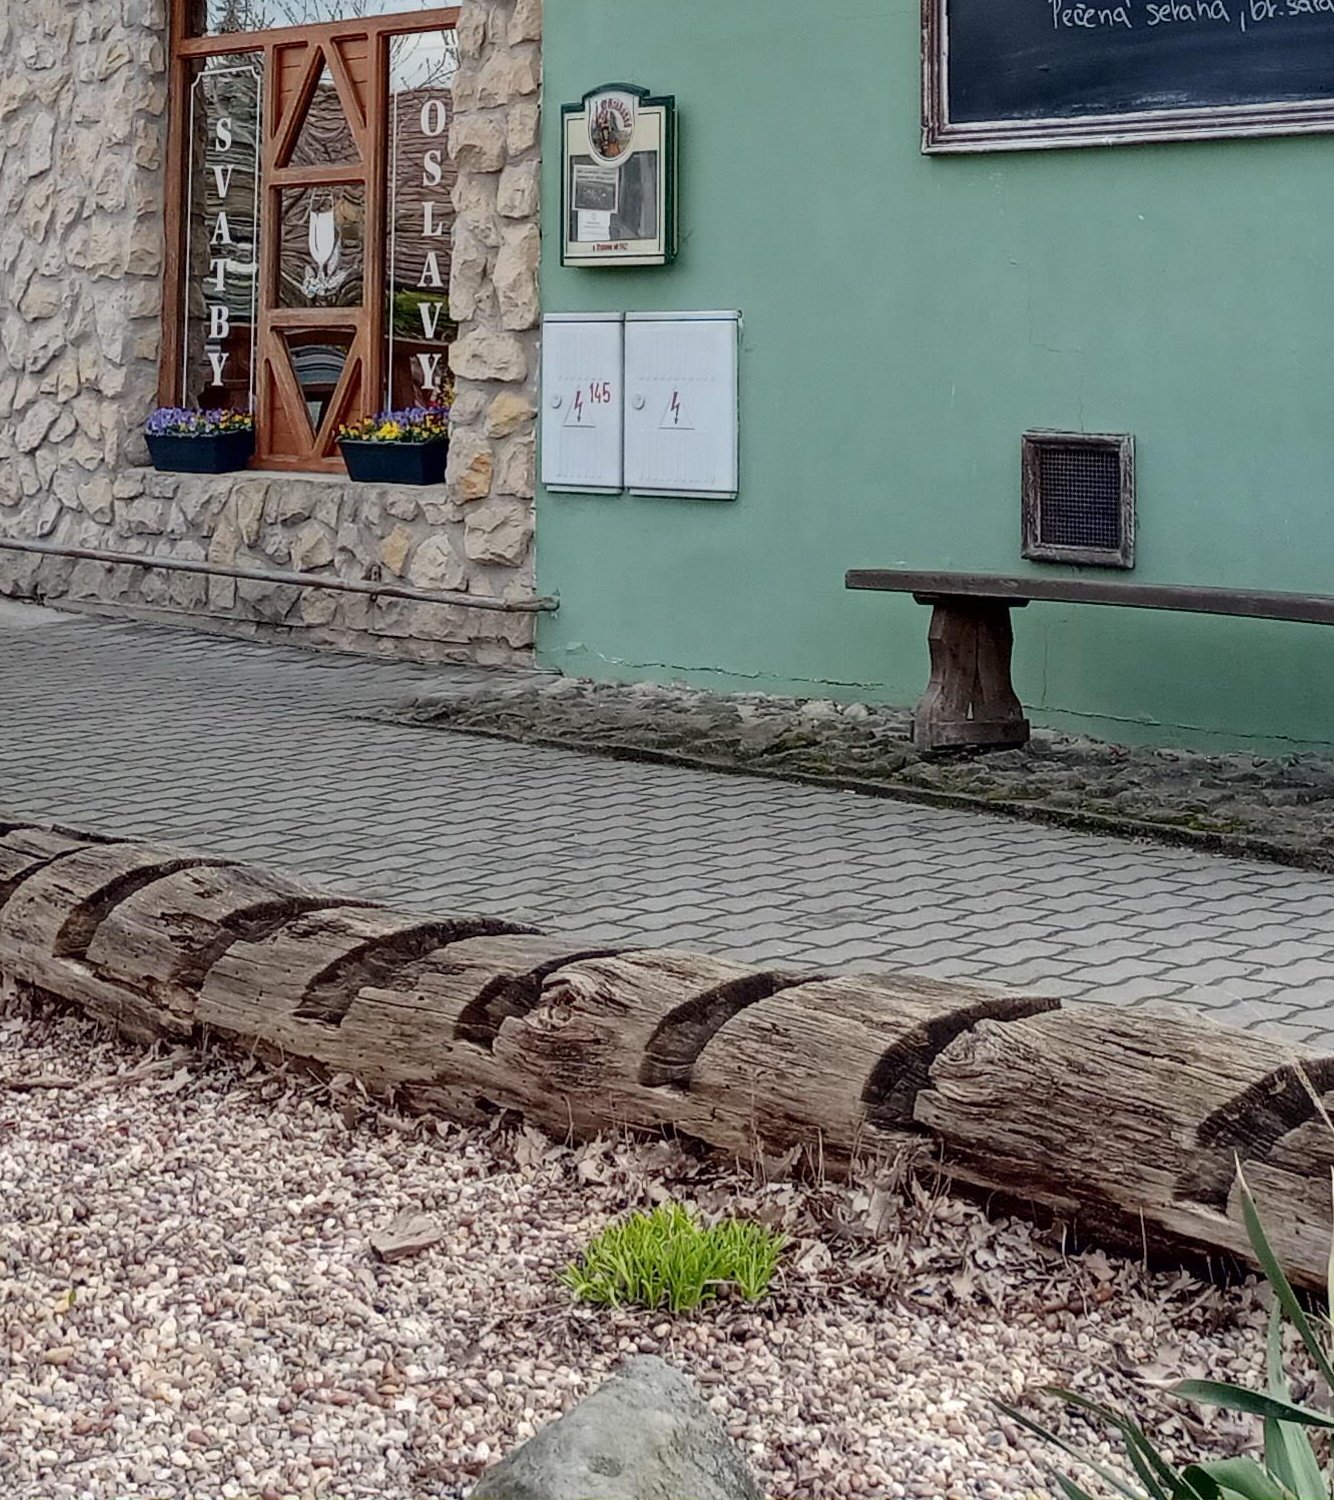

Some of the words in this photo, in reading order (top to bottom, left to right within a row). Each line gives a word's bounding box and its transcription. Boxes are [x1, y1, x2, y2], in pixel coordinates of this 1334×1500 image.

[207, 117, 234, 388] SVATBY
[415, 99, 447, 391] OSLAVY
[588, 381, 611, 405] 145
